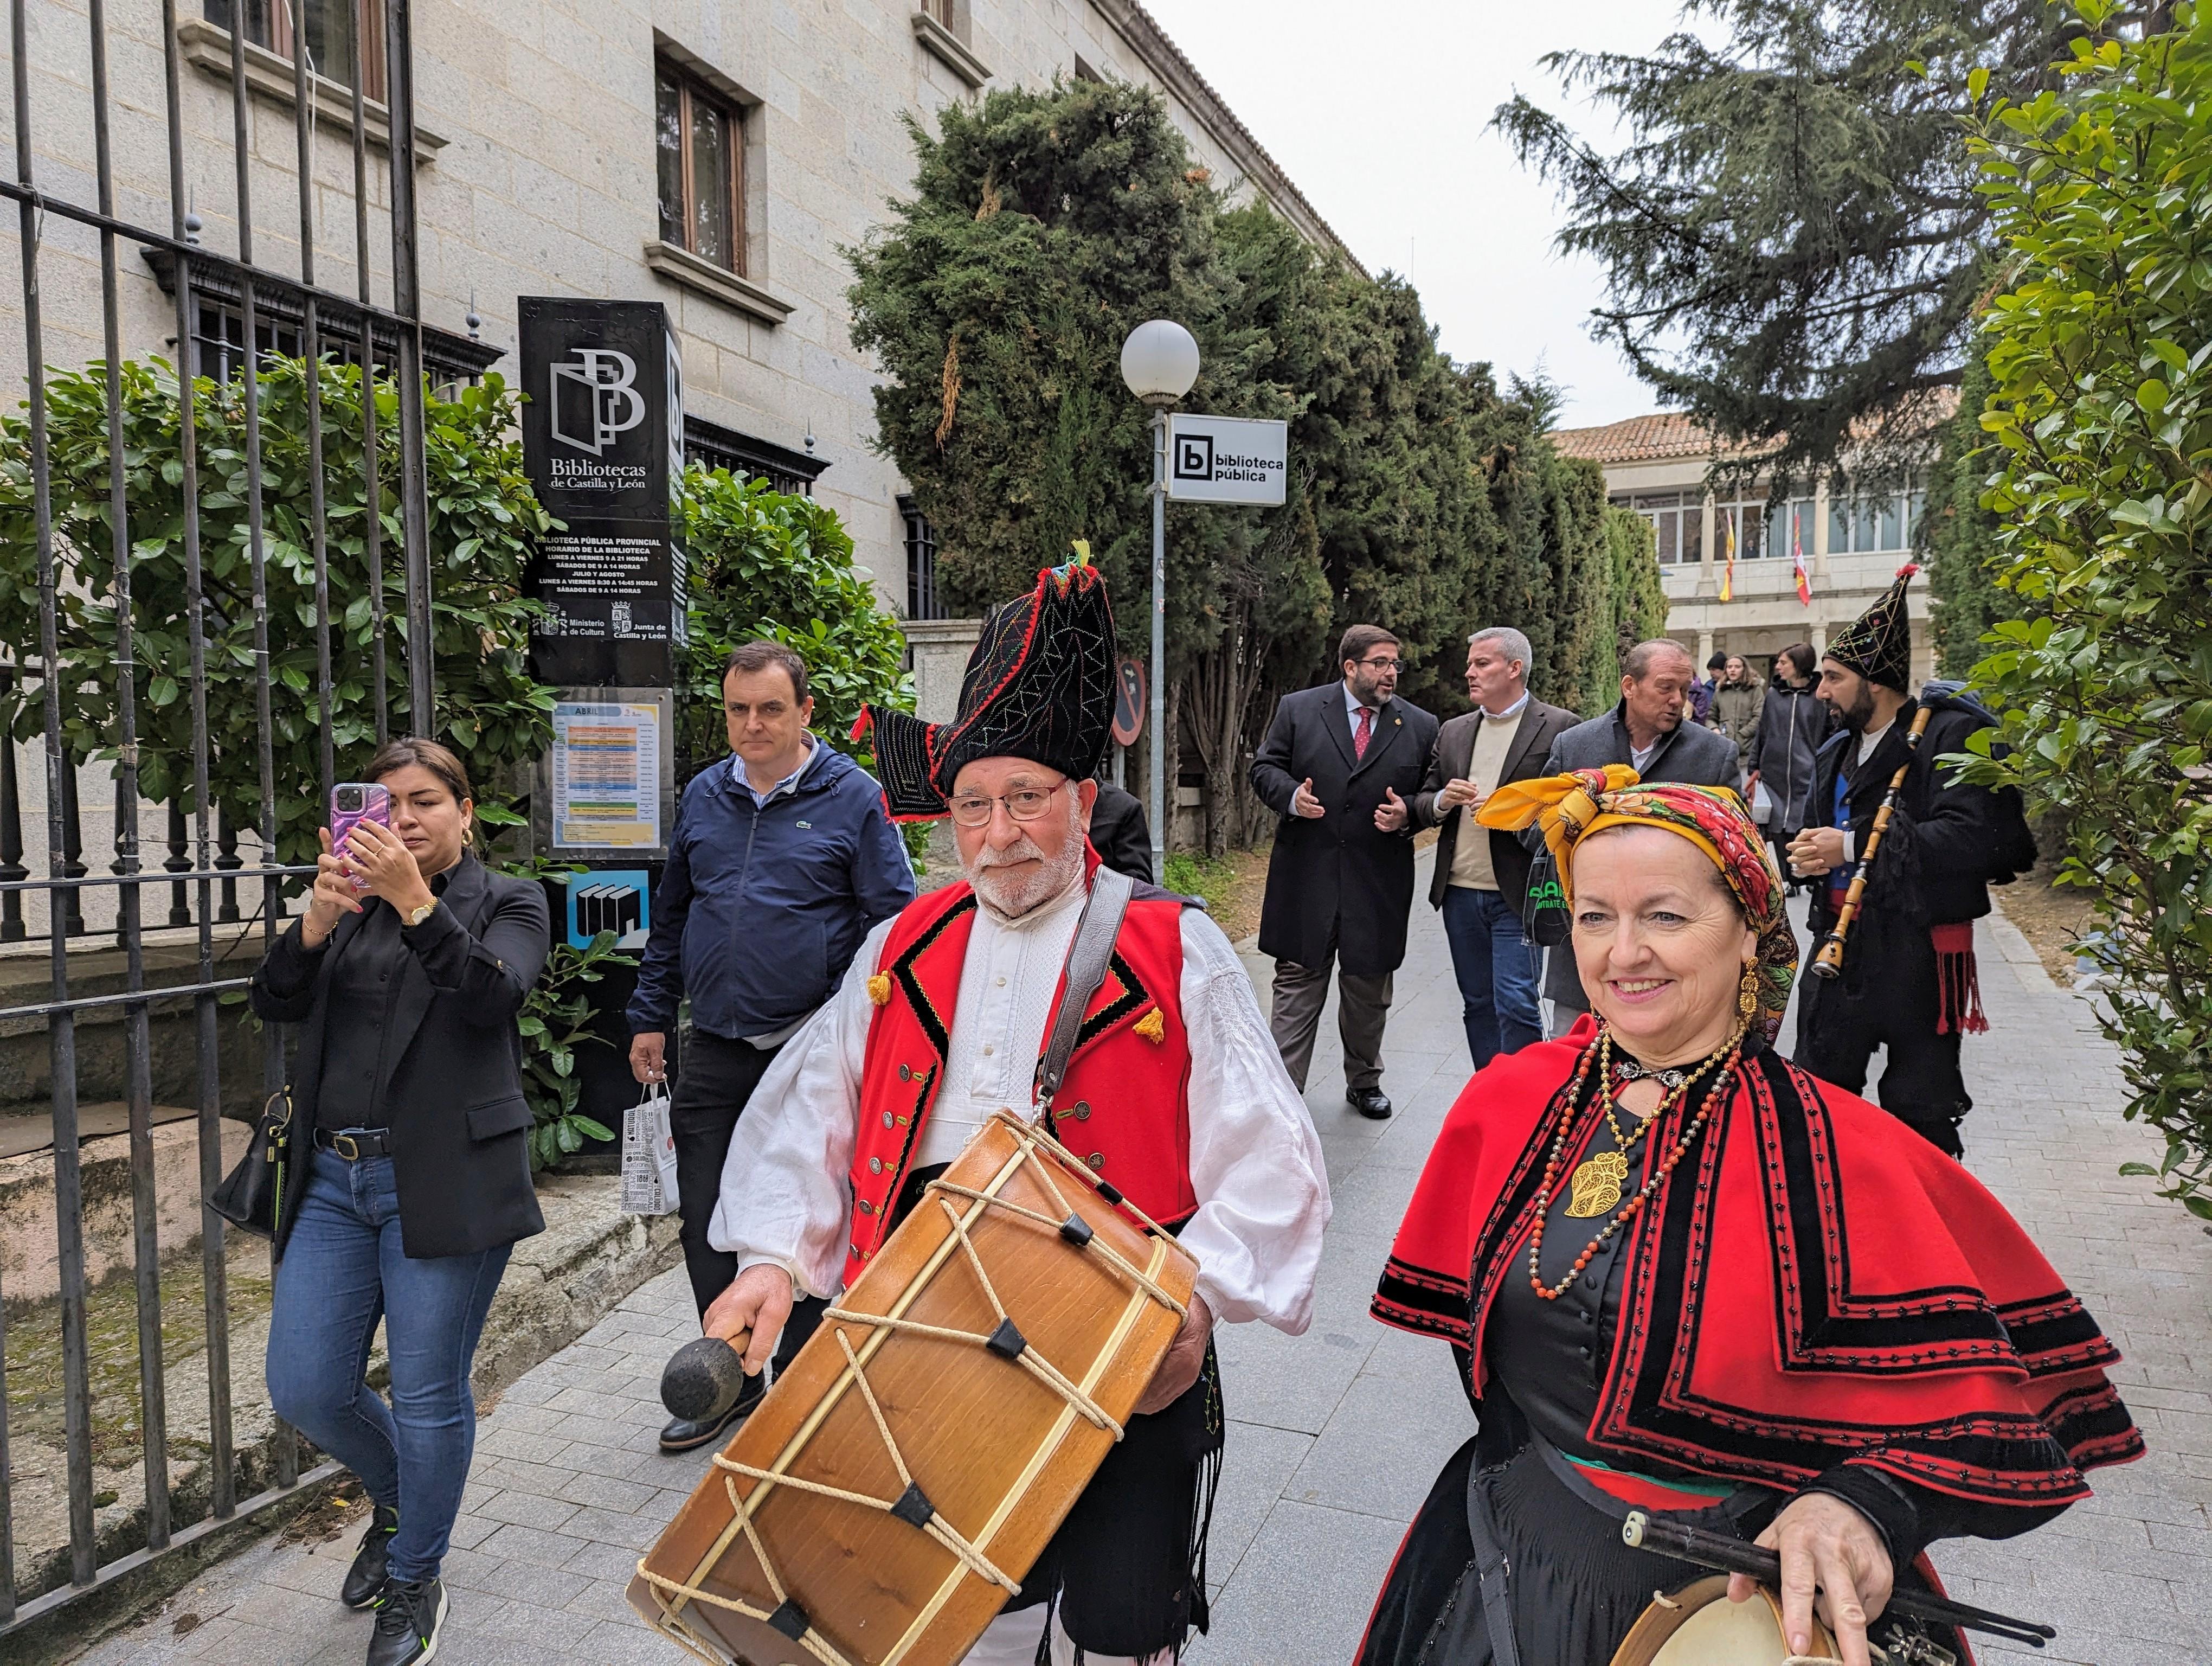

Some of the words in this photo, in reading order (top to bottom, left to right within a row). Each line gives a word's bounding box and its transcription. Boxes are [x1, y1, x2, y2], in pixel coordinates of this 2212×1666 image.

[550, 458, 646, 477] Bibliotecas
[1216, 454, 1283, 470] biblioteca
[1215, 468, 1266, 482] pública
[551, 477, 565, 488] de
[567, 477, 607, 488] Castilla
[609, 480, 615, 491] y
[618, 478, 646, 489] León
[581, 536, 614, 545] PÚBLICA
[616, 538, 661, 546] PROVINCIAL
[569, 619, 605, 627] Ministerio
[575, 707, 599, 715] ABRIL
[627, 1110, 635, 1135] NATURAL
